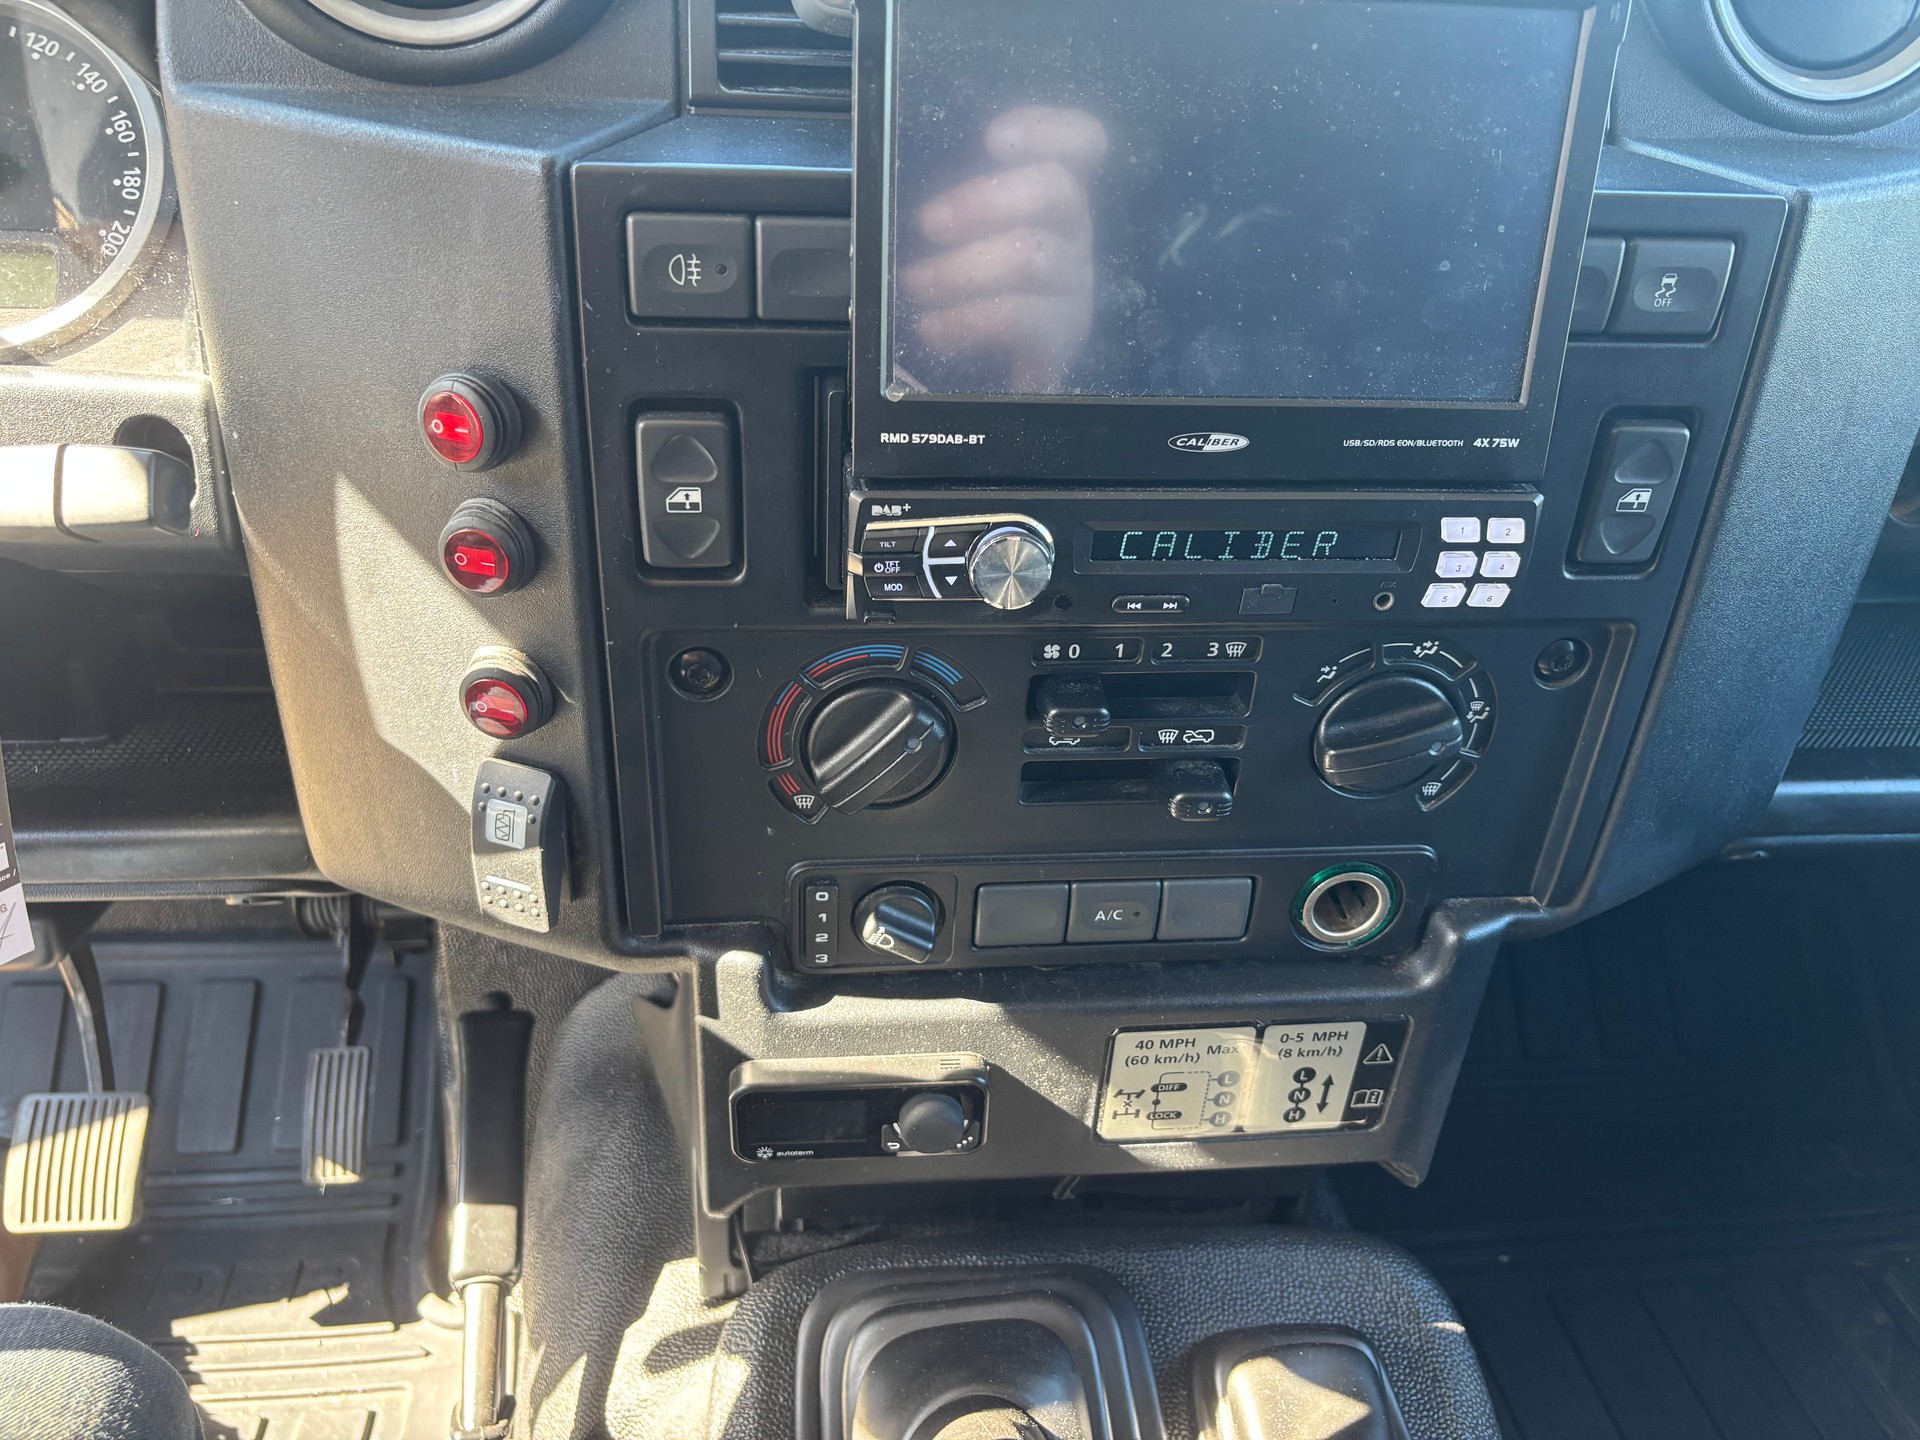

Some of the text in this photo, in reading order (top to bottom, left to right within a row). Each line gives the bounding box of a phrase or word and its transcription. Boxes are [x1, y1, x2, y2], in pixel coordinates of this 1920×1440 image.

[25, 31, 60, 57] 120
[75, 62, 108, 94] 140
[110, 110, 136, 144] 160
[122, 167, 141, 200] 180
[101, 220, 131, 257] 200
[1653, 298, 1673, 308] OFF
[880, 432, 986, 445] RMD 579DAB-BT
[1175, 437, 1240, 447] CALIBER
[1343, 438, 1520, 448] USB/SD/RDS EON/BLUETOOTH 4X 75W
[1505, 528, 1511, 536] 2
[1119, 530, 1339, 560] CALIBER
[1455, 565, 1462, 573] 3
[1498, 563, 1505, 571] 4
[884, 583, 903, 592] MOD
[1441, 595, 1448, 603] 5
[1486, 595, 1493, 603] 6
[1068, 643, 1081, 659] 0
[1115, 643, 1124, 658] 1
[1161, 642, 1173, 658] 2
[1207, 642, 1219, 657] 3
[815, 891, 829, 901] 0
[818, 913, 827, 922] 1
[1094, 909, 1123, 922] A/C
[815, 933, 829, 942] 2
[815, 953, 829, 964] 3
[1280, 1030, 1349, 1043] 0-5 MPH
[1135, 1037, 1196, 1050] 40 MPH
[1206, 1044, 1240, 1055] Max
[1278, 1045, 1343, 1060] (8 km/h)
[1124, 1052, 1201, 1067] (60 km/h)
[1158, 1083, 1180, 1091] DIFF
[1219, 1094, 1230, 1103] N
[1293, 1091, 1305, 1099] N
[1214, 1115, 1226, 1123] H
[1288, 1111, 1300, 1119] H
[776, 1149, 814, 1157] autoterm
